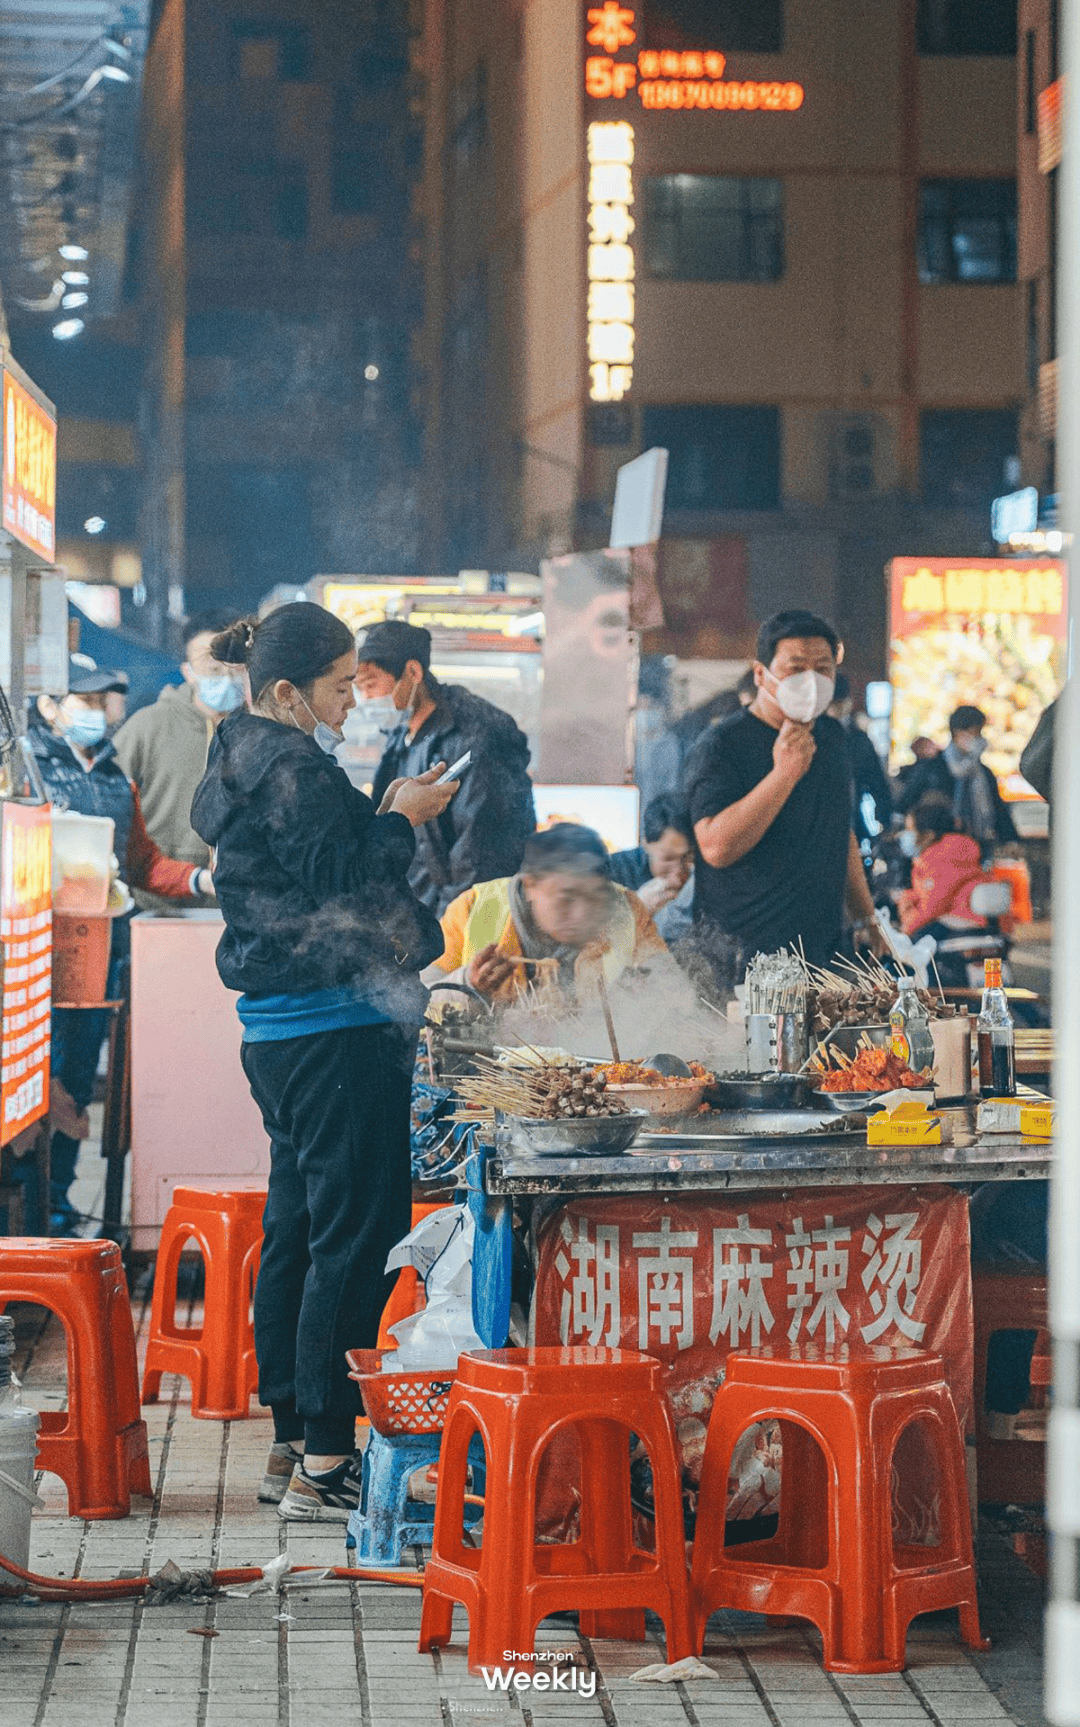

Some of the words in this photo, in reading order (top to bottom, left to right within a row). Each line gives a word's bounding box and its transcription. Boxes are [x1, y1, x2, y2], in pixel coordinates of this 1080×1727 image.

[586, 56, 636, 98] 5F
[554, 1213, 927, 1351] 湖南麻辣烫
